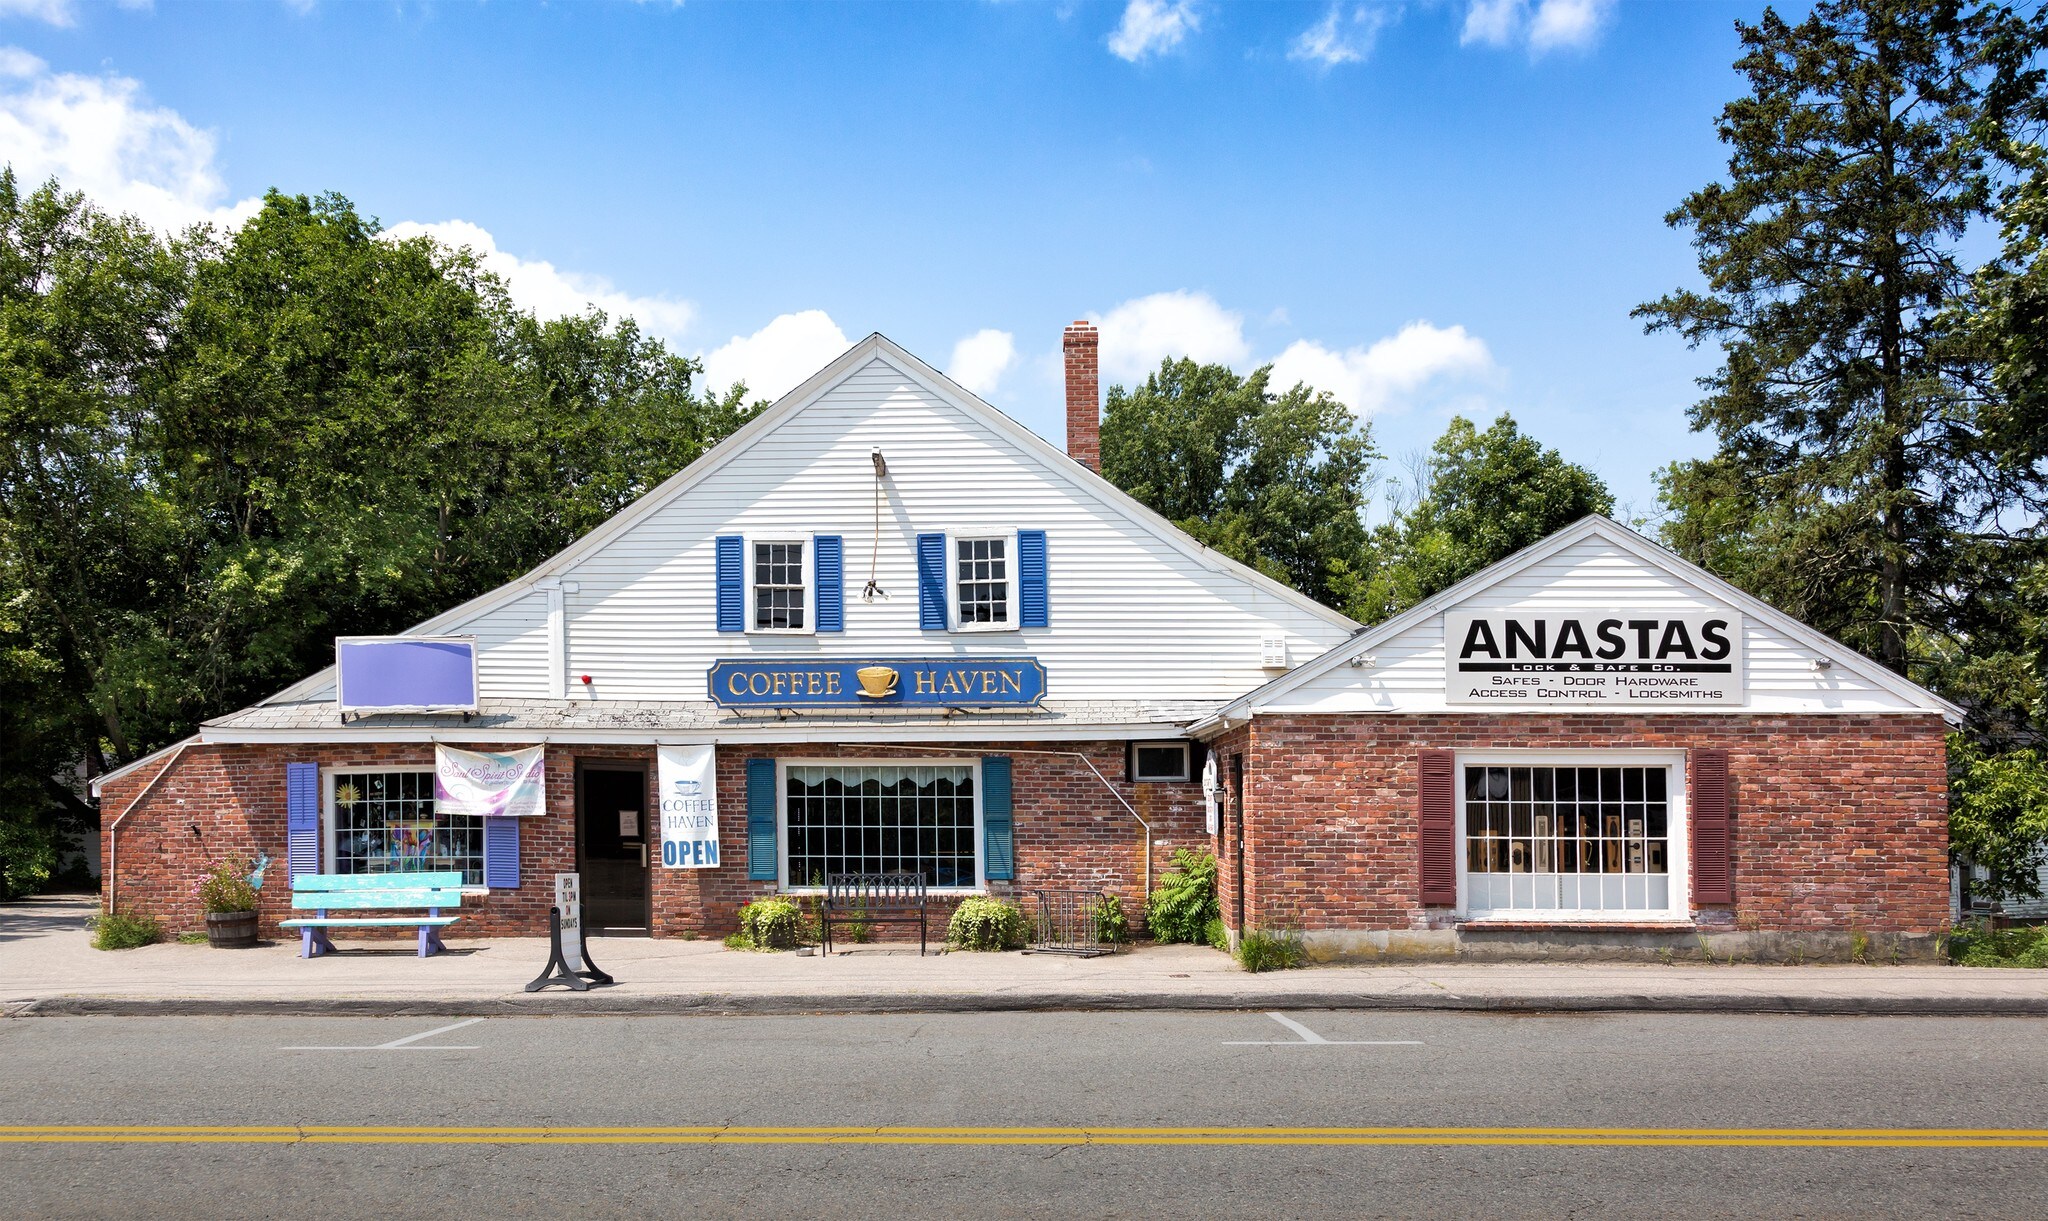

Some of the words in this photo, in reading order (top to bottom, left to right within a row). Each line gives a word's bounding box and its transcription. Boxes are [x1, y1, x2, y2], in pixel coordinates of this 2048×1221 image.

[1459, 618, 1732, 661] ANASTAS
[1511, 663, 1556, 672] LOCK
[1569, 663, 1580, 672] &
[1593, 663, 1639, 672] SAFE
[728, 672, 842, 696] COFFEE
[914, 670, 1022, 694] HAVEN
[1491, 675, 1541, 687] SAFES
[1563, 675, 1606, 687] DOOR
[1615, 675, 1699, 687] HARDWARE
[1468, 688, 1528, 699] ACCESS
[1537, 688, 1607, 699] CONTROL
[1628, 688, 1723, 699] LOCKSMITHS
[441, 762, 471, 779] Soul
[471, 764, 505, 785] Spirit
[506, 763, 541, 780] Stdio
[663, 799, 715, 813] COFFEE
[668, 815, 714, 829] HAVEN
[664, 840, 717, 865] OPEN
[564, 878, 573, 889] OPEN
[566, 906, 571, 915] ON
[561, 918, 577, 930] SUNDAYS
